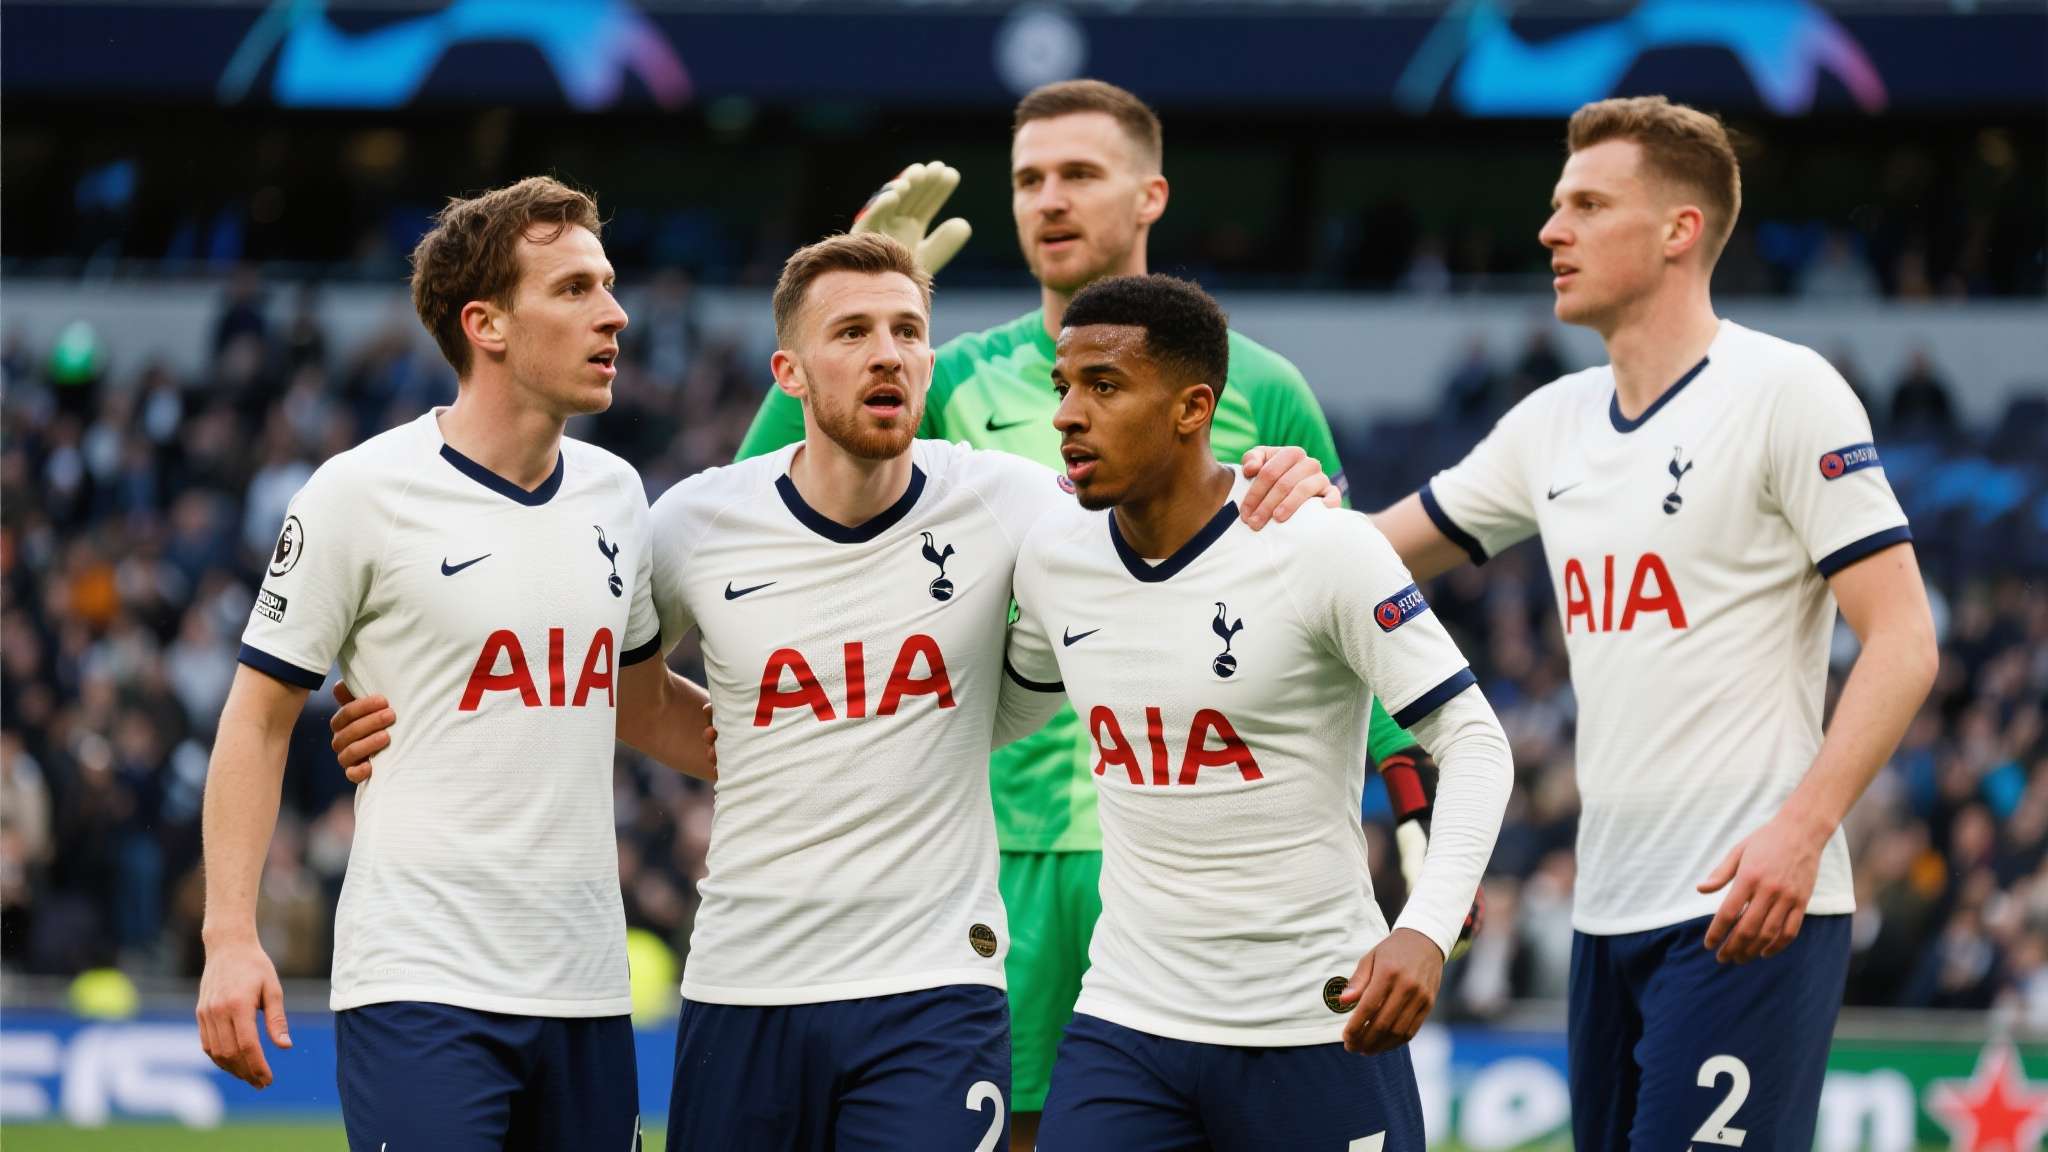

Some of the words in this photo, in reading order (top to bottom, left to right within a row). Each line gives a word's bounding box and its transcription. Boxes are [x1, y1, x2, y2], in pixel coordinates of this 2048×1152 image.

[1564, 552, 1688, 634] AIA
[458, 627, 615, 711] AIA
[753, 634, 956, 727] AIA
[1089, 705, 1264, 786] AIA
[1691, 1054, 1751, 1148] 2
